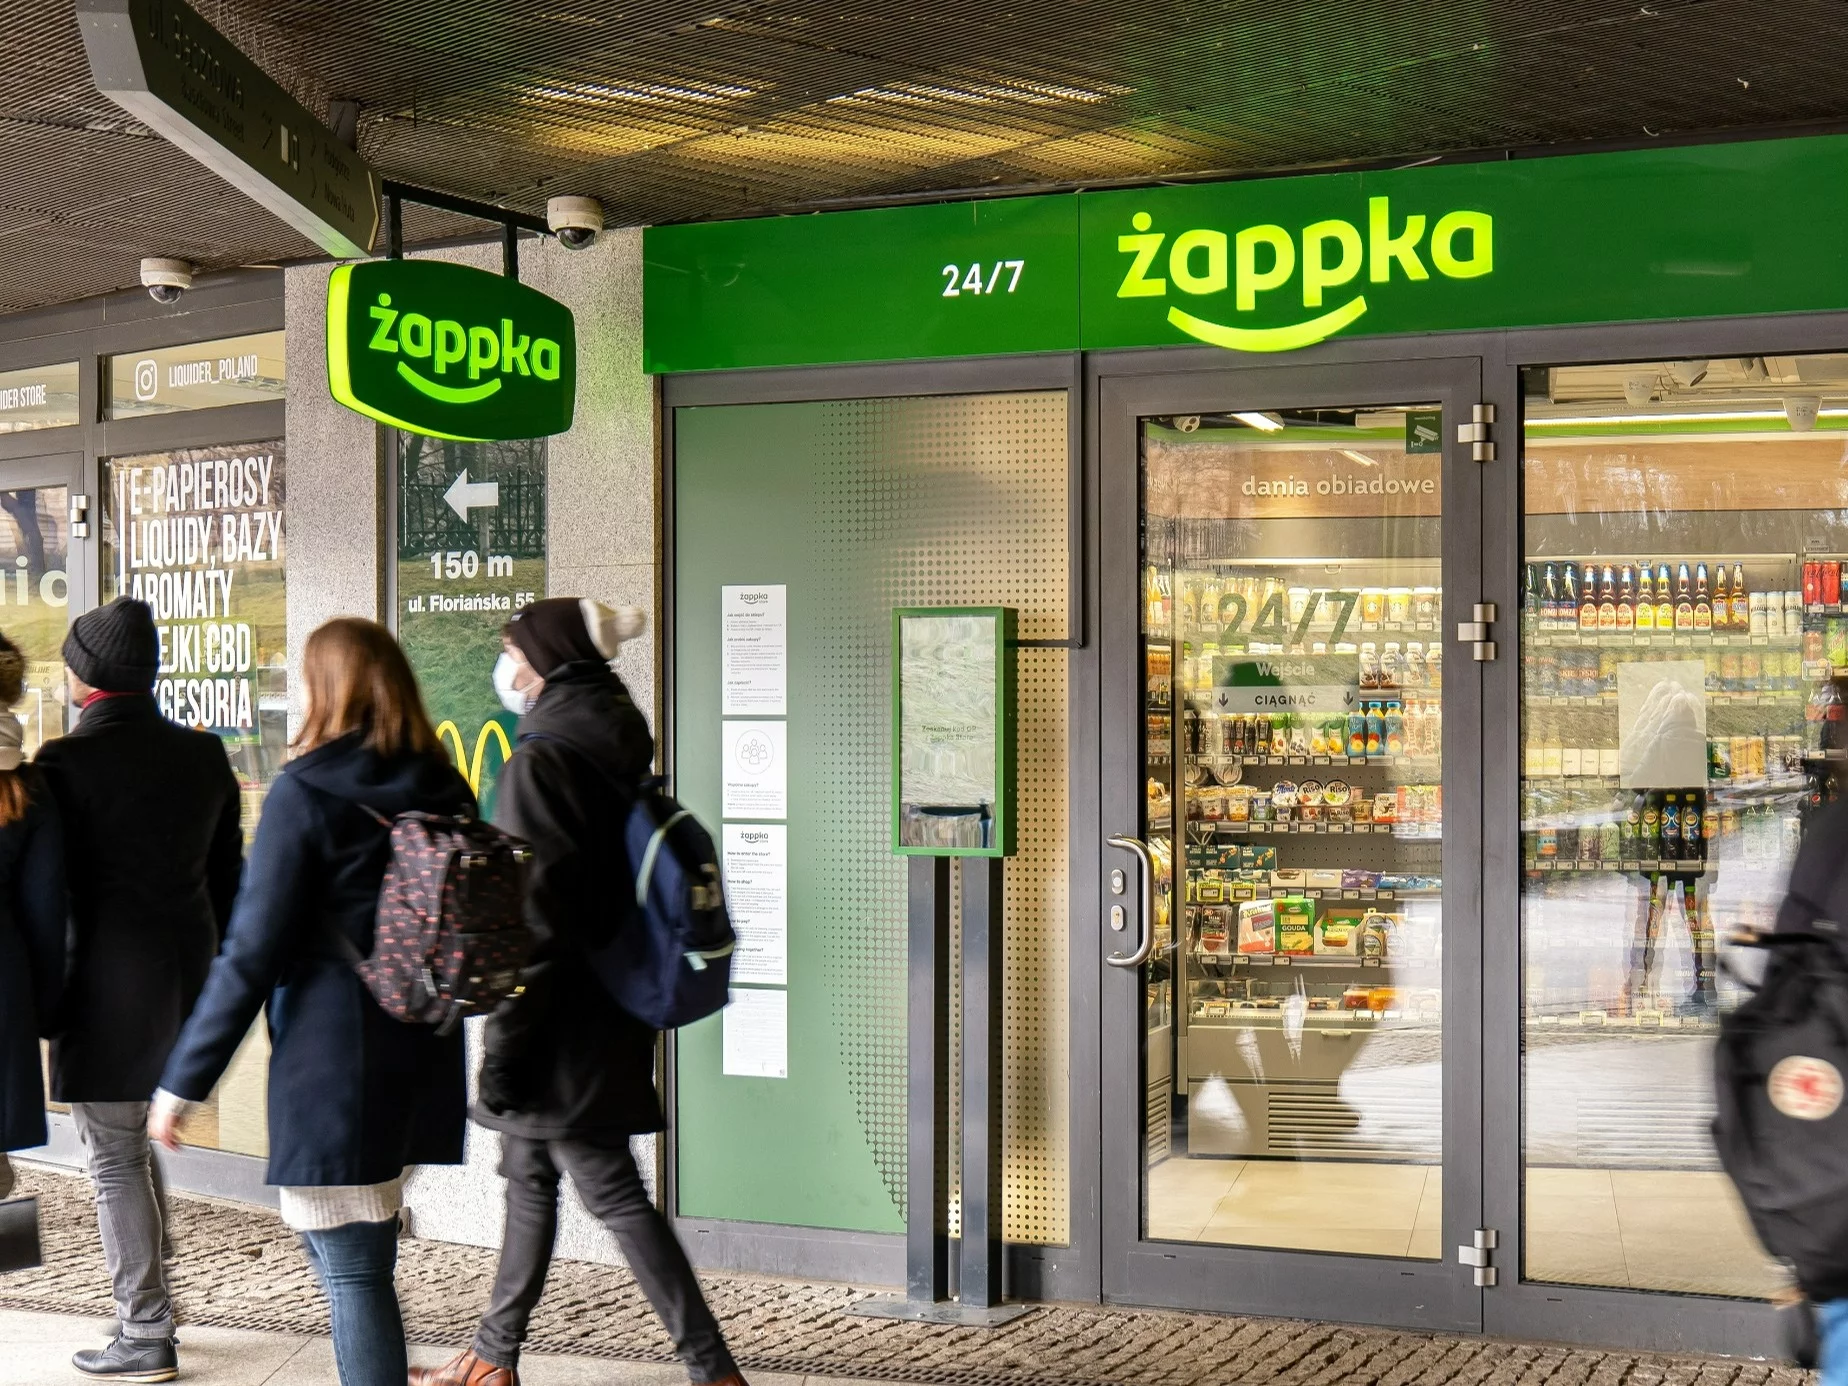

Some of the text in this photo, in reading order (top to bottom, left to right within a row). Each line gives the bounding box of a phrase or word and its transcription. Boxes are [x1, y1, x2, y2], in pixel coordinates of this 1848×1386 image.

[1116, 195, 1494, 312] żappka
[941, 259, 1025, 298] 24/7
[368, 292, 561, 382] żappka
[168, 354, 259, 389] LIQUIDER_POLAND
[0, 384, 47, 411] IDER STORE
[130, 455, 274, 516] E-PAPIEROSY
[1241, 474, 1435, 498] dania obiadowe
[130, 510, 283, 570] LIQUIDY, BAZY
[430, 550, 514, 579] 150 m
[408, 595, 427, 613] ul.
[429, 592, 511, 613] Floriańska
[740, 592, 769, 602] żappka
[1217, 590, 1361, 647] 24/7
[158, 623, 251, 674] EJKI CBD
[1256, 661, 1315, 679] Wejście
[153, 677, 252, 728] CESORIA
[1254, 692, 1316, 709] CIĄGNĄĆ
[740, 830, 769, 840] żappka
